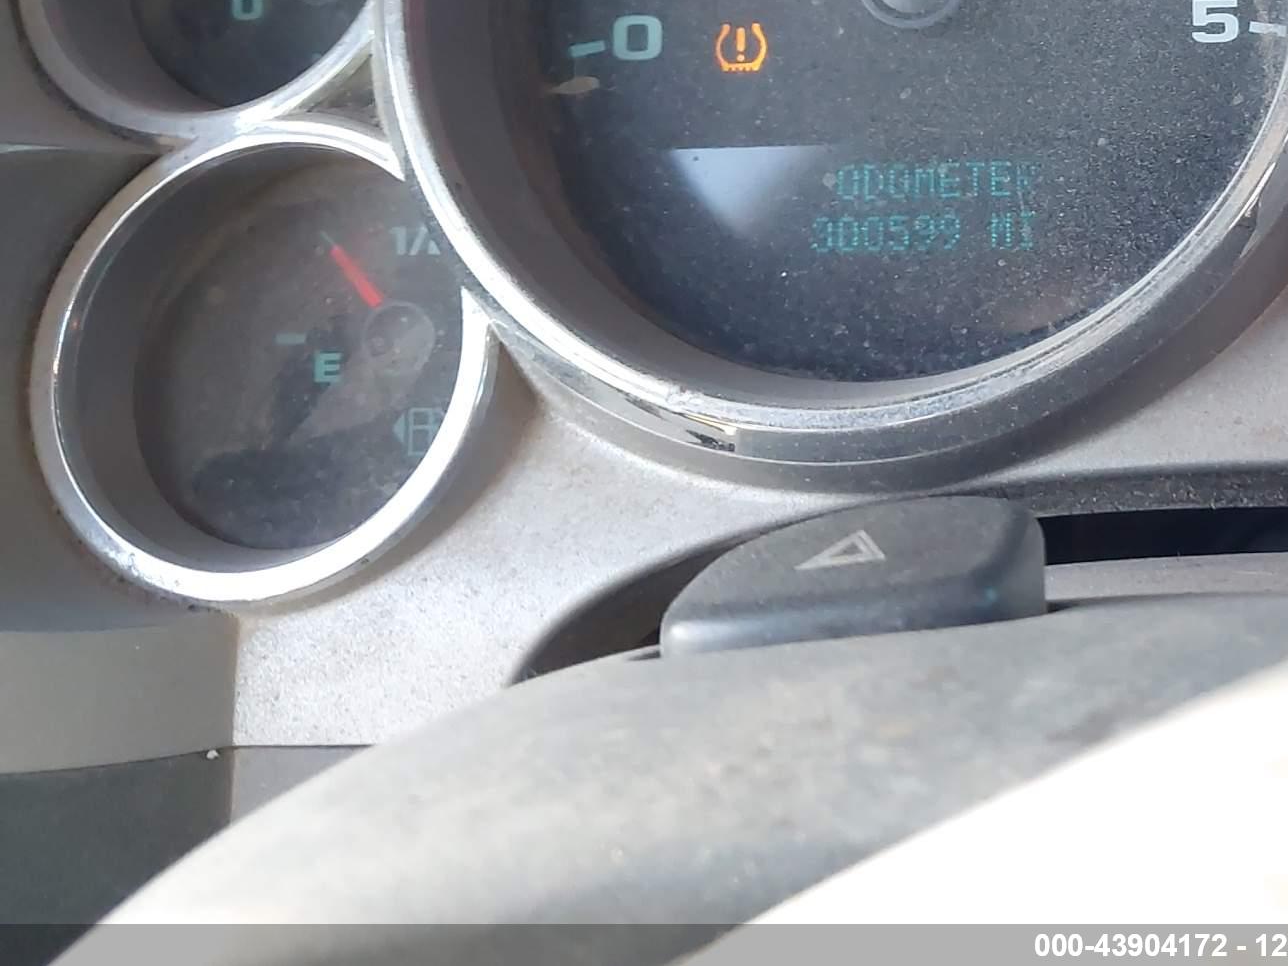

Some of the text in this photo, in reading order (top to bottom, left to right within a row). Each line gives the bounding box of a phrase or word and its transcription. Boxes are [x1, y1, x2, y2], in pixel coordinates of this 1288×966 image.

[613, 15, 663, 61] 0
[837, 160, 1035, 202] ODOMETER
[990, 210, 1034, 251] MI
[313, 351, 343, 383] E
